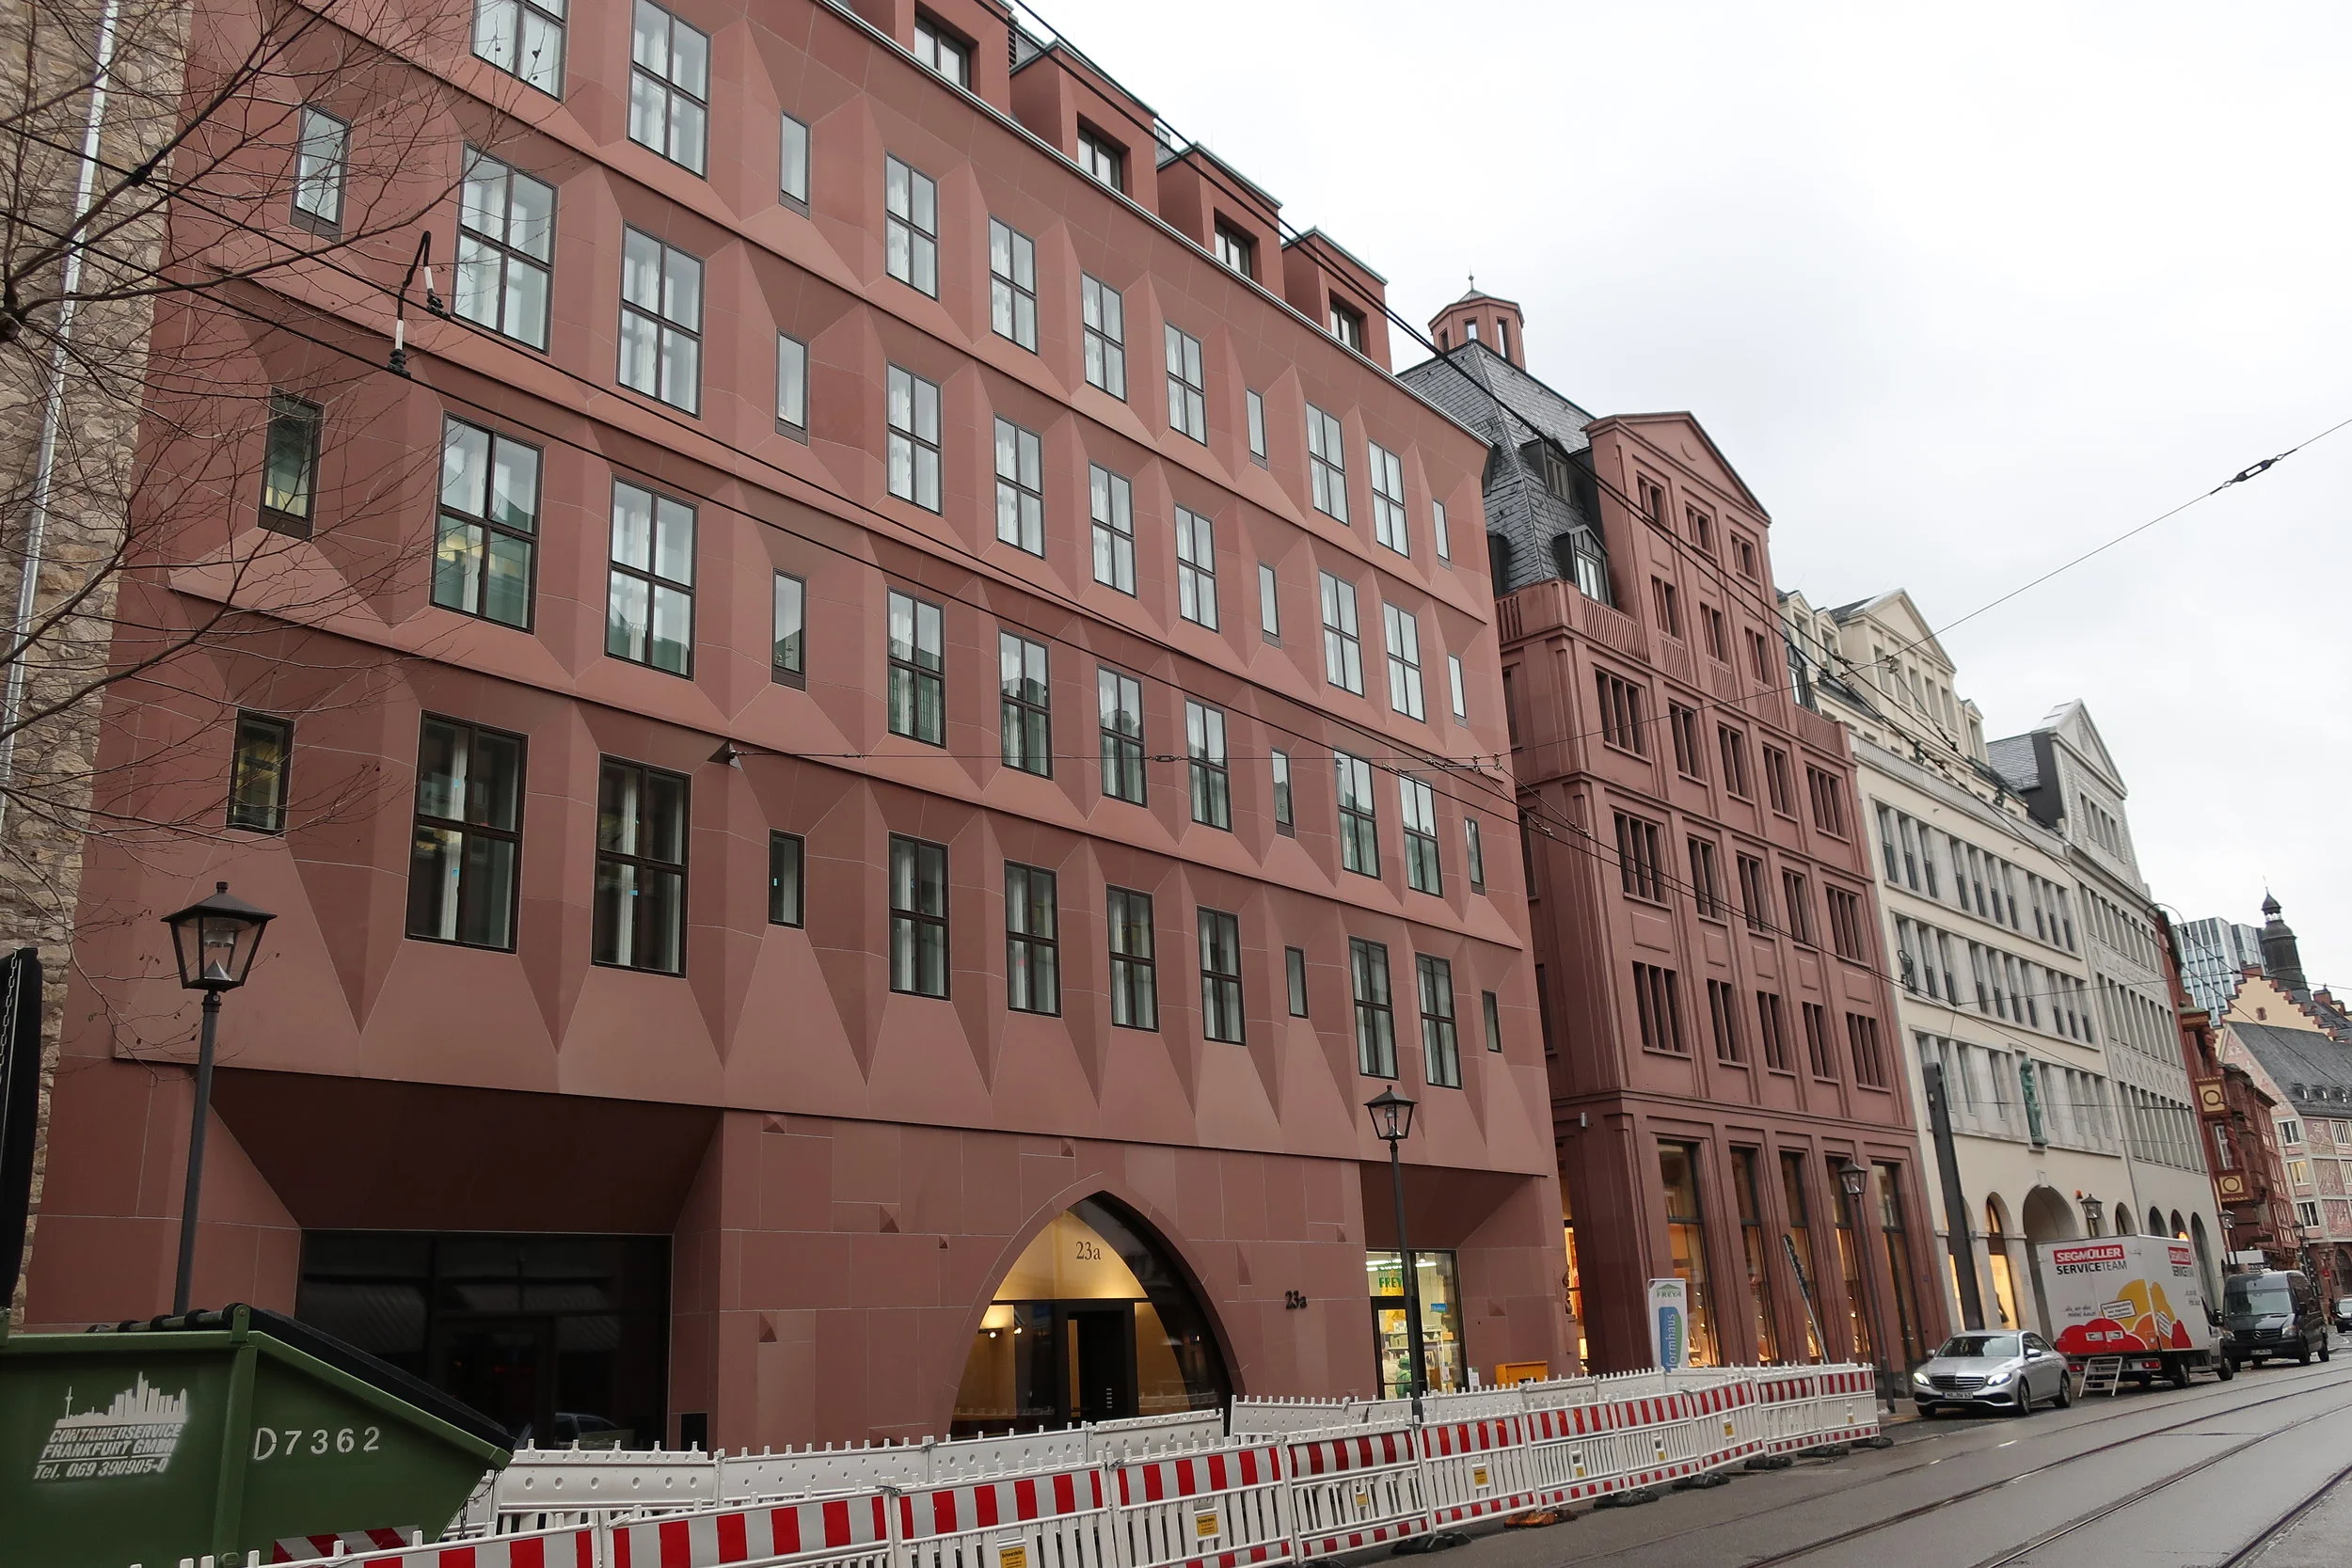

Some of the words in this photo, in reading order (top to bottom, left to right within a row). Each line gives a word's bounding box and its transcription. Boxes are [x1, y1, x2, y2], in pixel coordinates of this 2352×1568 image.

[1075, 1241, 1101, 1260] 23a
[2056, 1246, 2122, 1262] SEGMÜLLER
[2056, 1259, 2128, 1275] SERVICETEAM
[1378, 1276, 1403, 1289] FREY
[1285, 1290, 1308, 1309] 23a
[49, 1423, 183, 1444] CONTAINERSERVICE
[40, 1440, 133, 1459] FRANKFURT
[66, 1461, 97, 1478] 069
[98, 1457, 169, 1477] 390905-0
